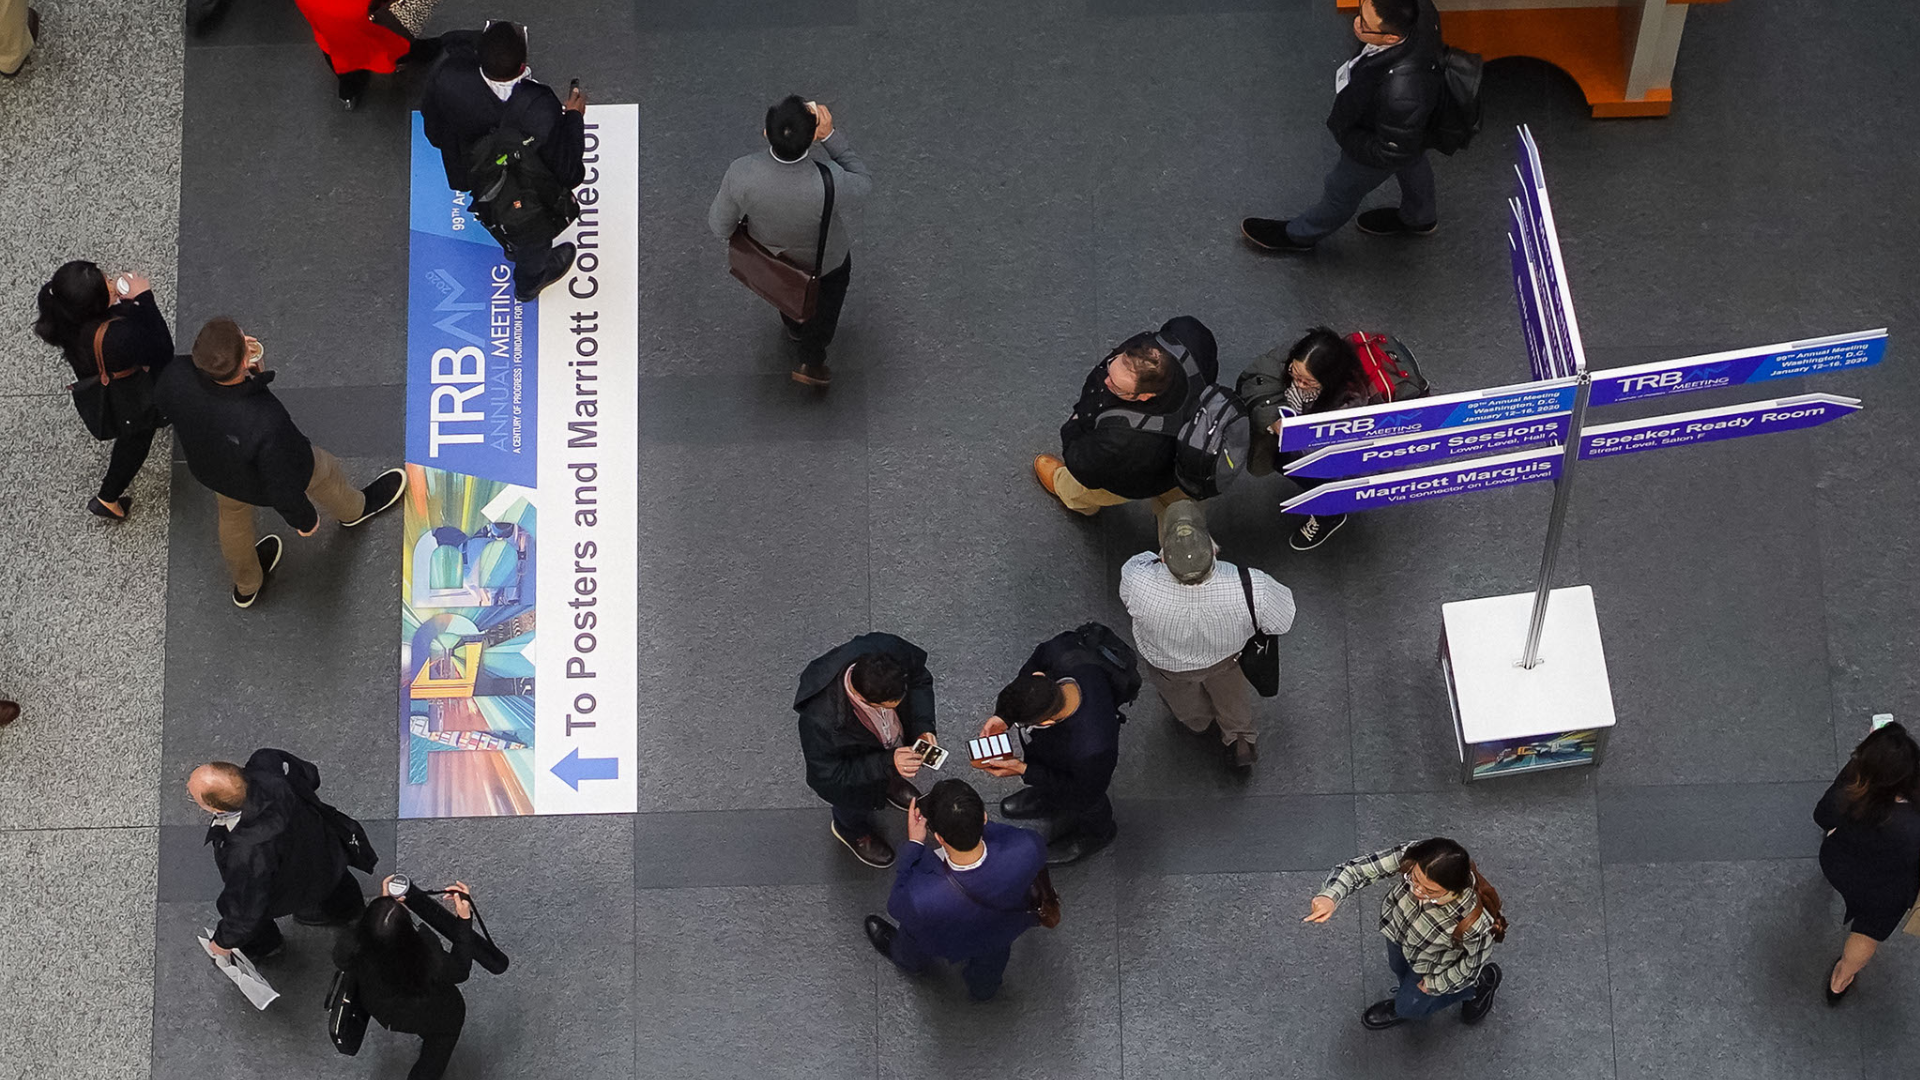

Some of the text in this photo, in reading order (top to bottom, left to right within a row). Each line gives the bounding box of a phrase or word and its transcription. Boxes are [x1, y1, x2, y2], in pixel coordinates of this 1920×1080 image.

[452, 208, 465, 230] 99TH
[425, 270, 452, 295] 2020
[513, 305, 523, 319] FOR
[513, 320, 523, 363] FOUNDATION
[1796, 349, 1830, 359] Annual
[1832, 343, 1869, 354] Meeting
[490, 264, 511, 452] ANNUAL MEETING
[568, 311, 599, 448] Marriott
[1617, 371, 1683, 393] TRB
[1770, 366, 1810, 376] January
[513, 367, 522, 403] PROGRESS
[1672, 377, 1730, 391] MEETING
[429, 346, 486, 458] TRB
[1487, 396, 1521, 406] Annual
[1523, 391, 1560, 401] Meeting
[513, 405, 522, 416] OF
[1463, 412, 1502, 423] January
[1537, 404, 1560, 412] 2020
[512, 418, 521, 446] CENTURY
[1309, 418, 1375, 439] TRB
[1365, 423, 1423, 437] MEETING
[1590, 406, 1826, 448] Speaker Ready Room
[512, 446, 521, 454] A
[1362, 441, 1441, 463] Poster
[1448, 422, 1559, 447] Sessions
[1449, 444, 1484, 454] Lower
[1524, 433, 1546, 442] Hall
[1589, 445, 1623, 455] Street
[1661, 434, 1693, 444] Salon
[1355, 461, 1552, 501] Marriott Marquis
[1388, 494, 1407, 502] Via
[1409, 485, 1464, 499] connector
[1485, 476, 1519, 487] Lower
[1522, 470, 1552, 481] Level
[568, 463, 598, 527] and
[566, 541, 598, 679] Posters
[566, 693, 597, 736] To
